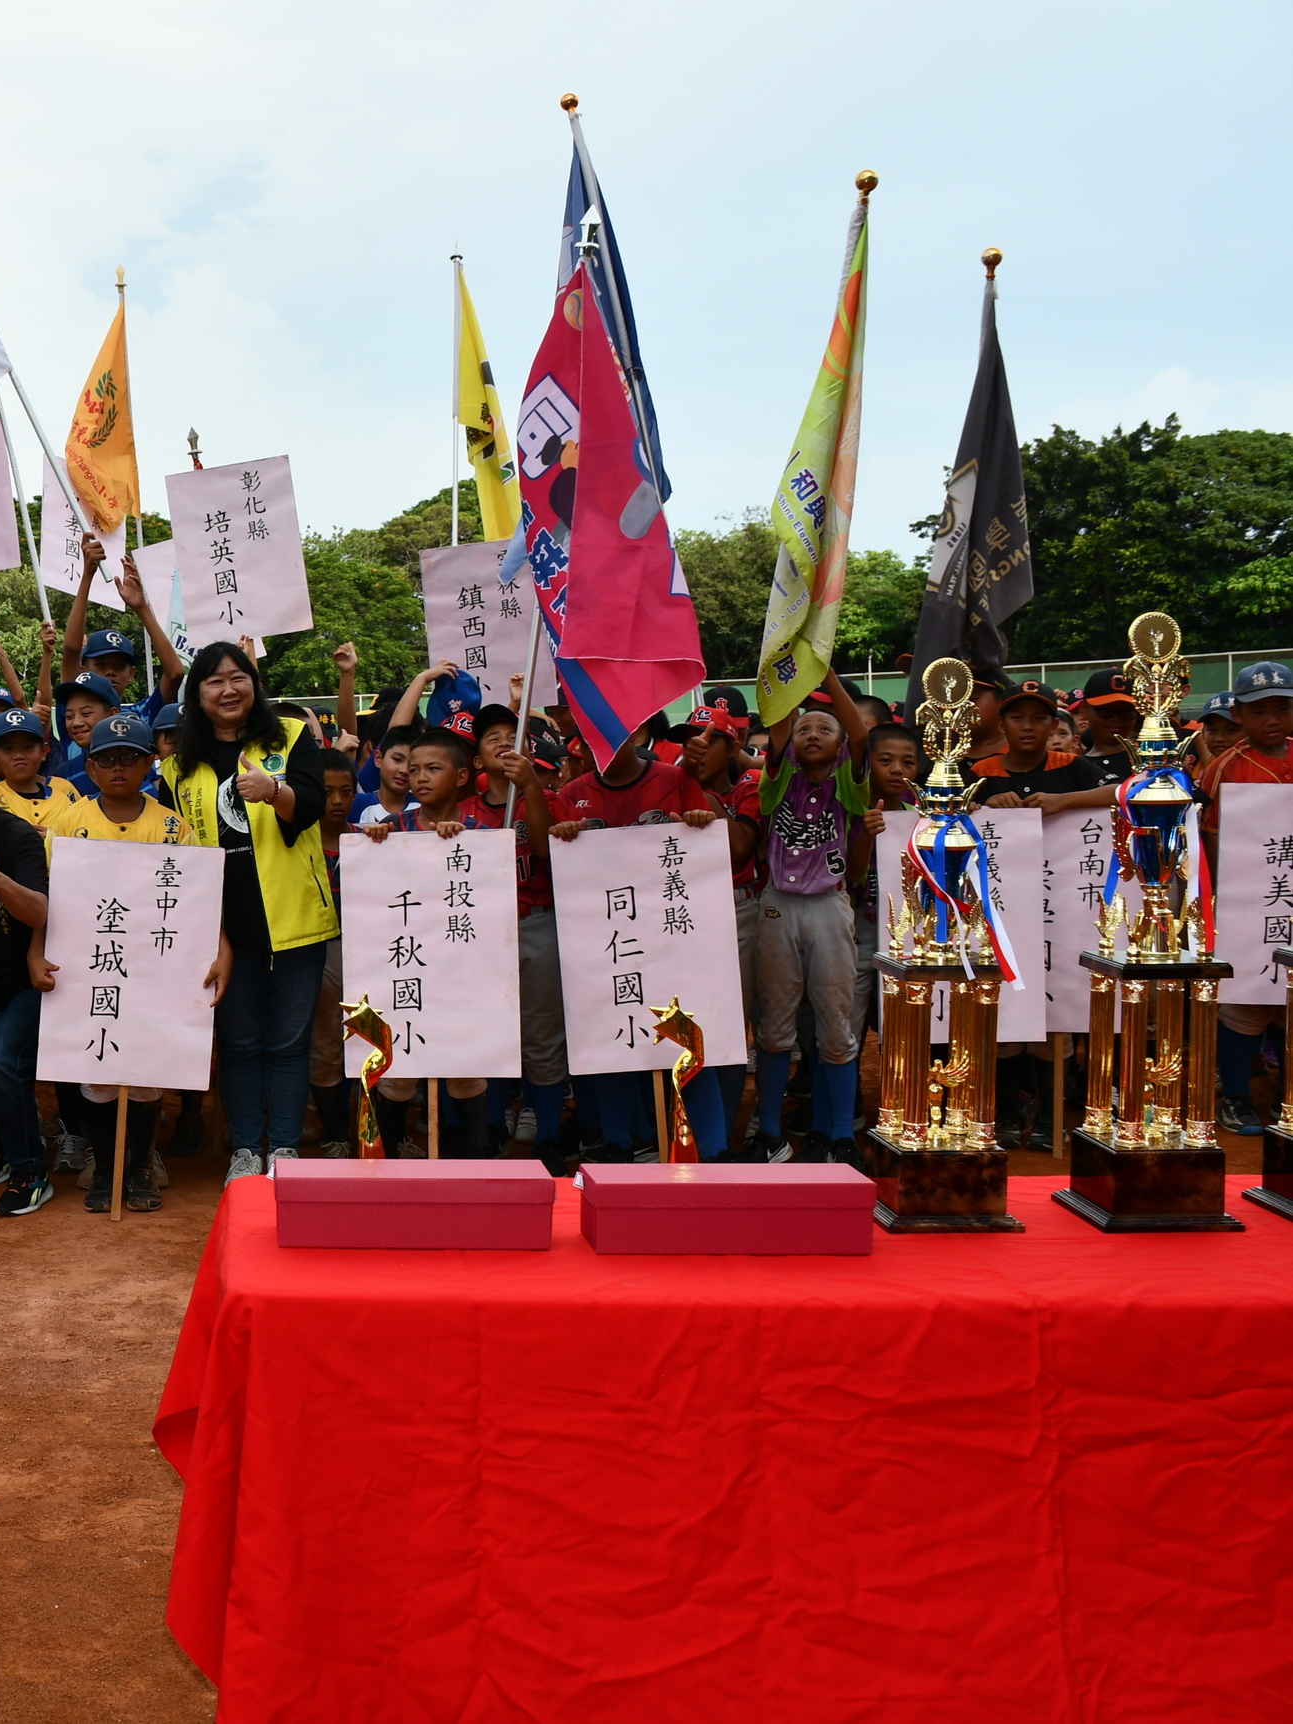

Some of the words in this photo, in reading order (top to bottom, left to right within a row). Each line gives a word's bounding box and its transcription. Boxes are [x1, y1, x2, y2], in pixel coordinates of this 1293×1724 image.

[240, 471, 270, 541] 彰化縣
[205, 510, 244, 626] 培英國小
[1022, 680, 1039, 693] C
[1251, 671, 1284, 688] 講美
[150, 856, 183, 957] 臺中市
[443, 842, 477, 944] 南投縣
[658, 836, 695, 936] 嘉義縣
[825, 848, 846, 876] 5
[1077, 817, 1105, 906] 台南市
[84, 897, 131, 1063] 塗城國小
[387, 890, 427, 1055] 千秋國小
[605, 885, 650, 1049] 同仁國小
